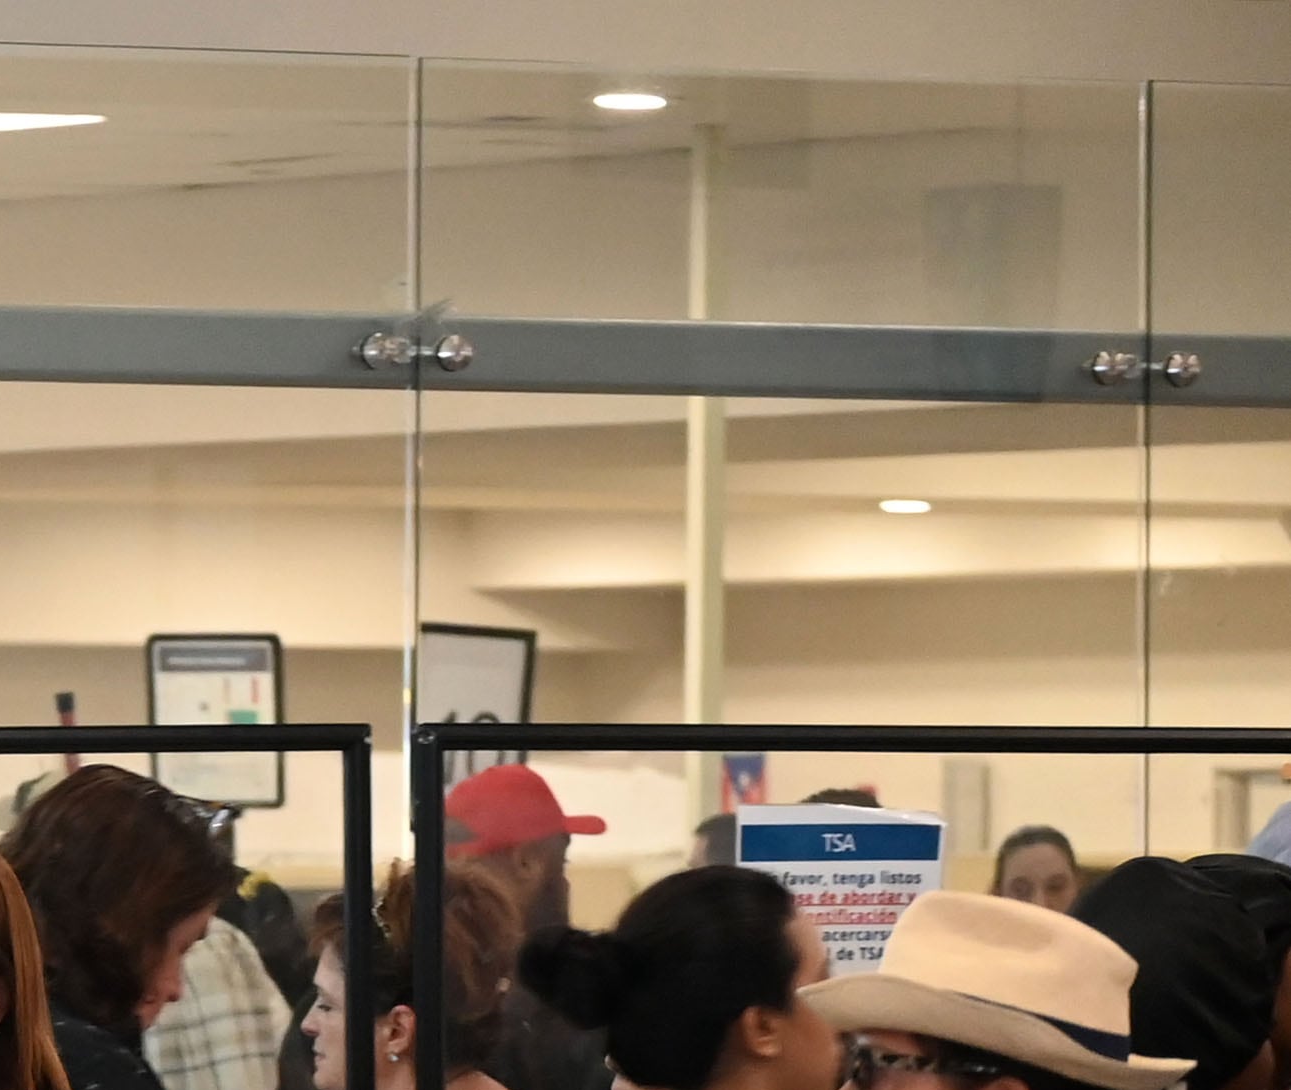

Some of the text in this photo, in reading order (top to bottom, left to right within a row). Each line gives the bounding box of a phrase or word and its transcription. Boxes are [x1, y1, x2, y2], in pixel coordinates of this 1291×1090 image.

[821, 833, 856, 852] TSA
[782, 871, 828, 886] favor,
[832, 873, 875, 888] tenga
[880, 870, 922, 885] listos
[819, 890, 837, 905] de
[843, 891, 902, 905] abordar
[823, 930, 892, 942] acercars
[836, 946, 854, 960] de
